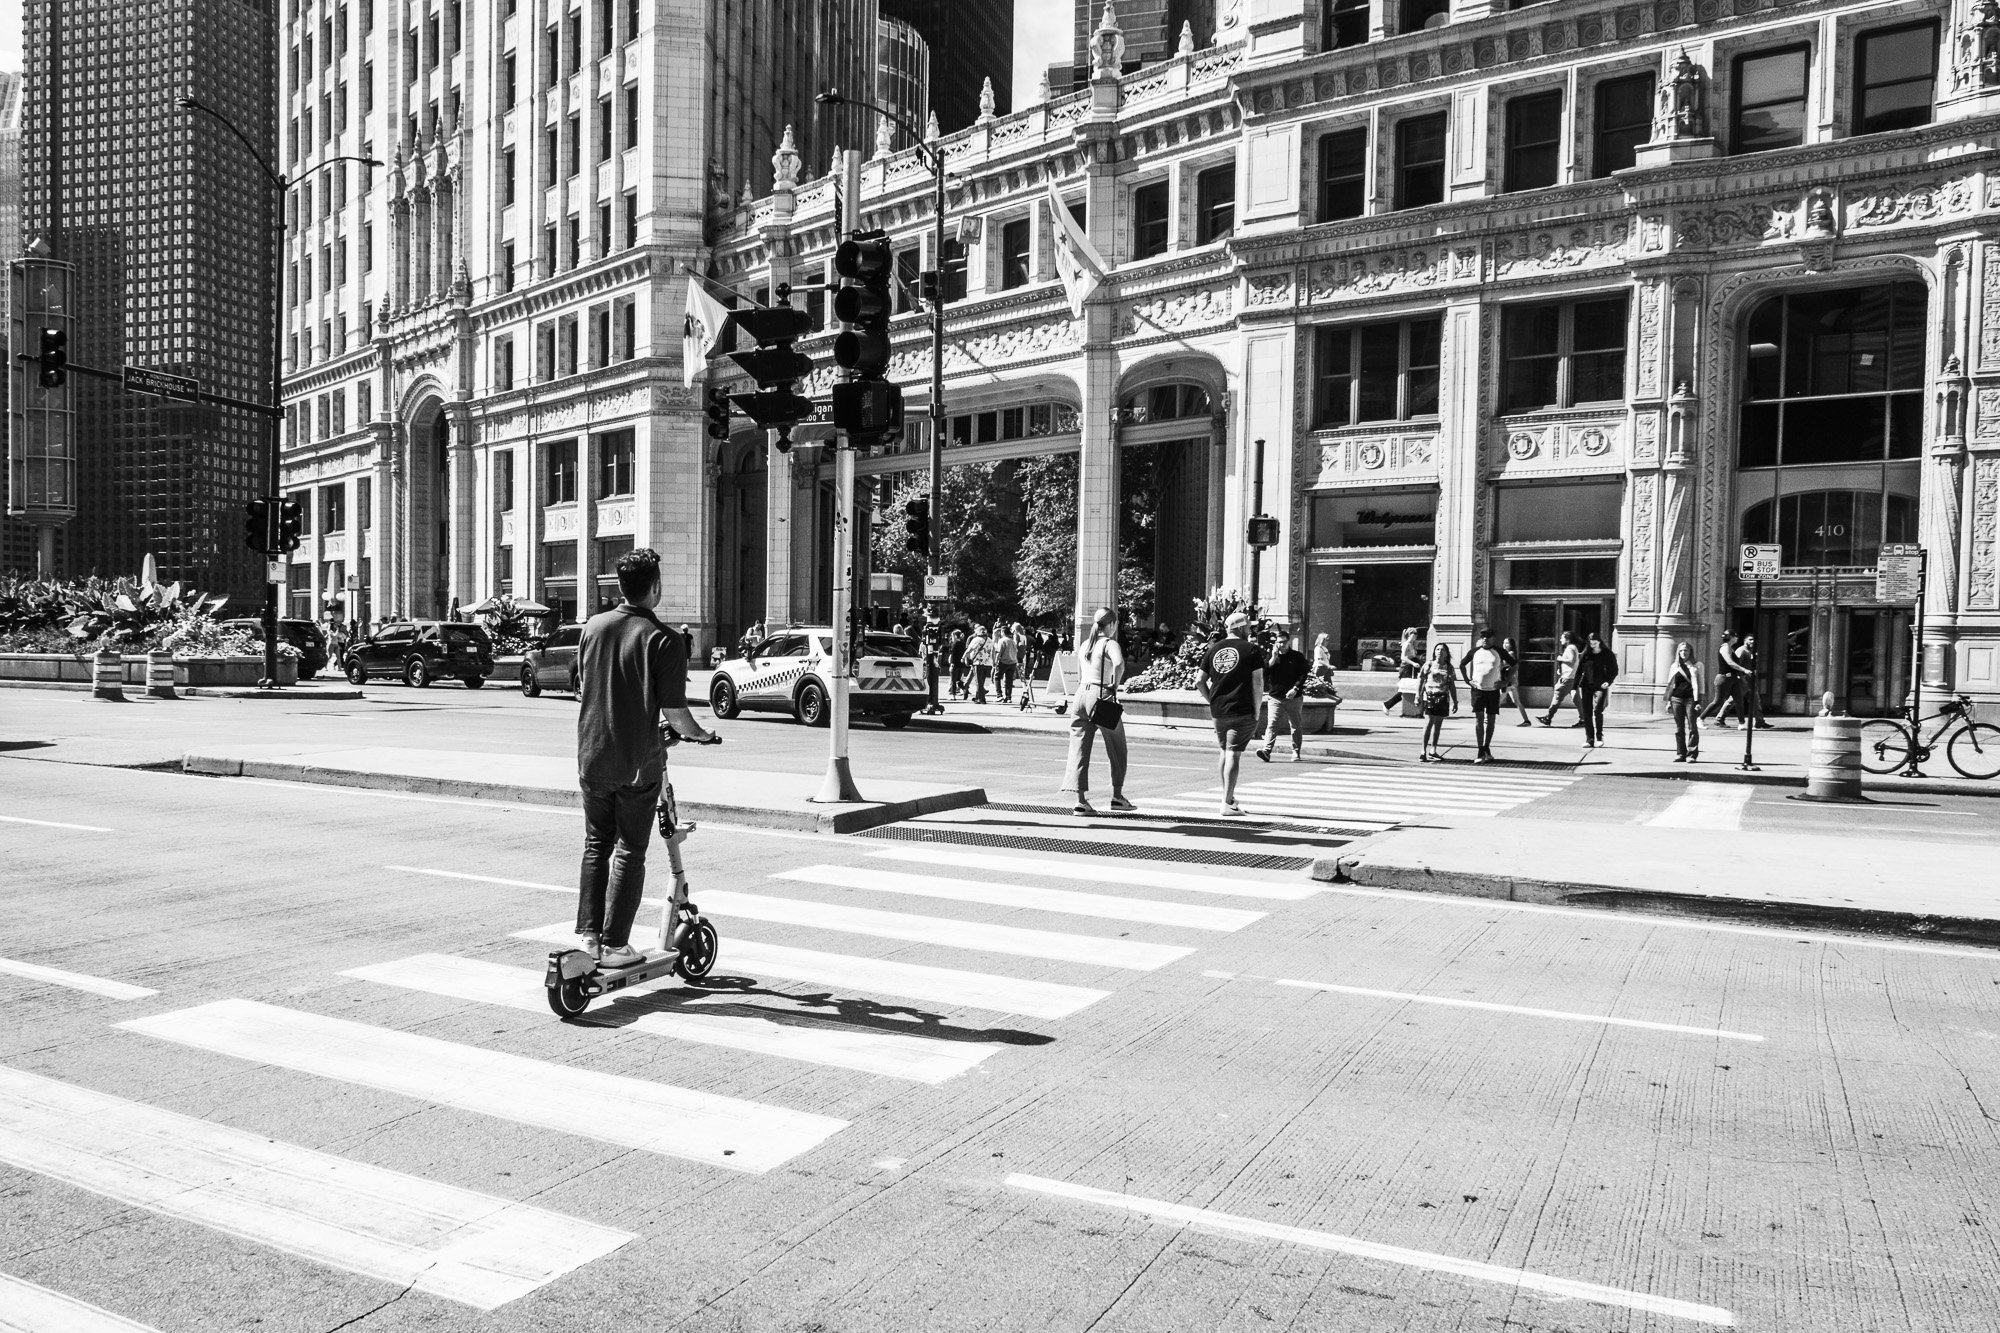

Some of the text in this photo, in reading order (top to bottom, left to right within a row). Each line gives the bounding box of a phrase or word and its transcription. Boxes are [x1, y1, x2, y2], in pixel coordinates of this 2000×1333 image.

[127, 375, 144, 384] JACK
[145, 378, 185, 393] BRICKHOUSE
[821, 413, 826, 421] E
[1814, 525, 1844, 536] 410
